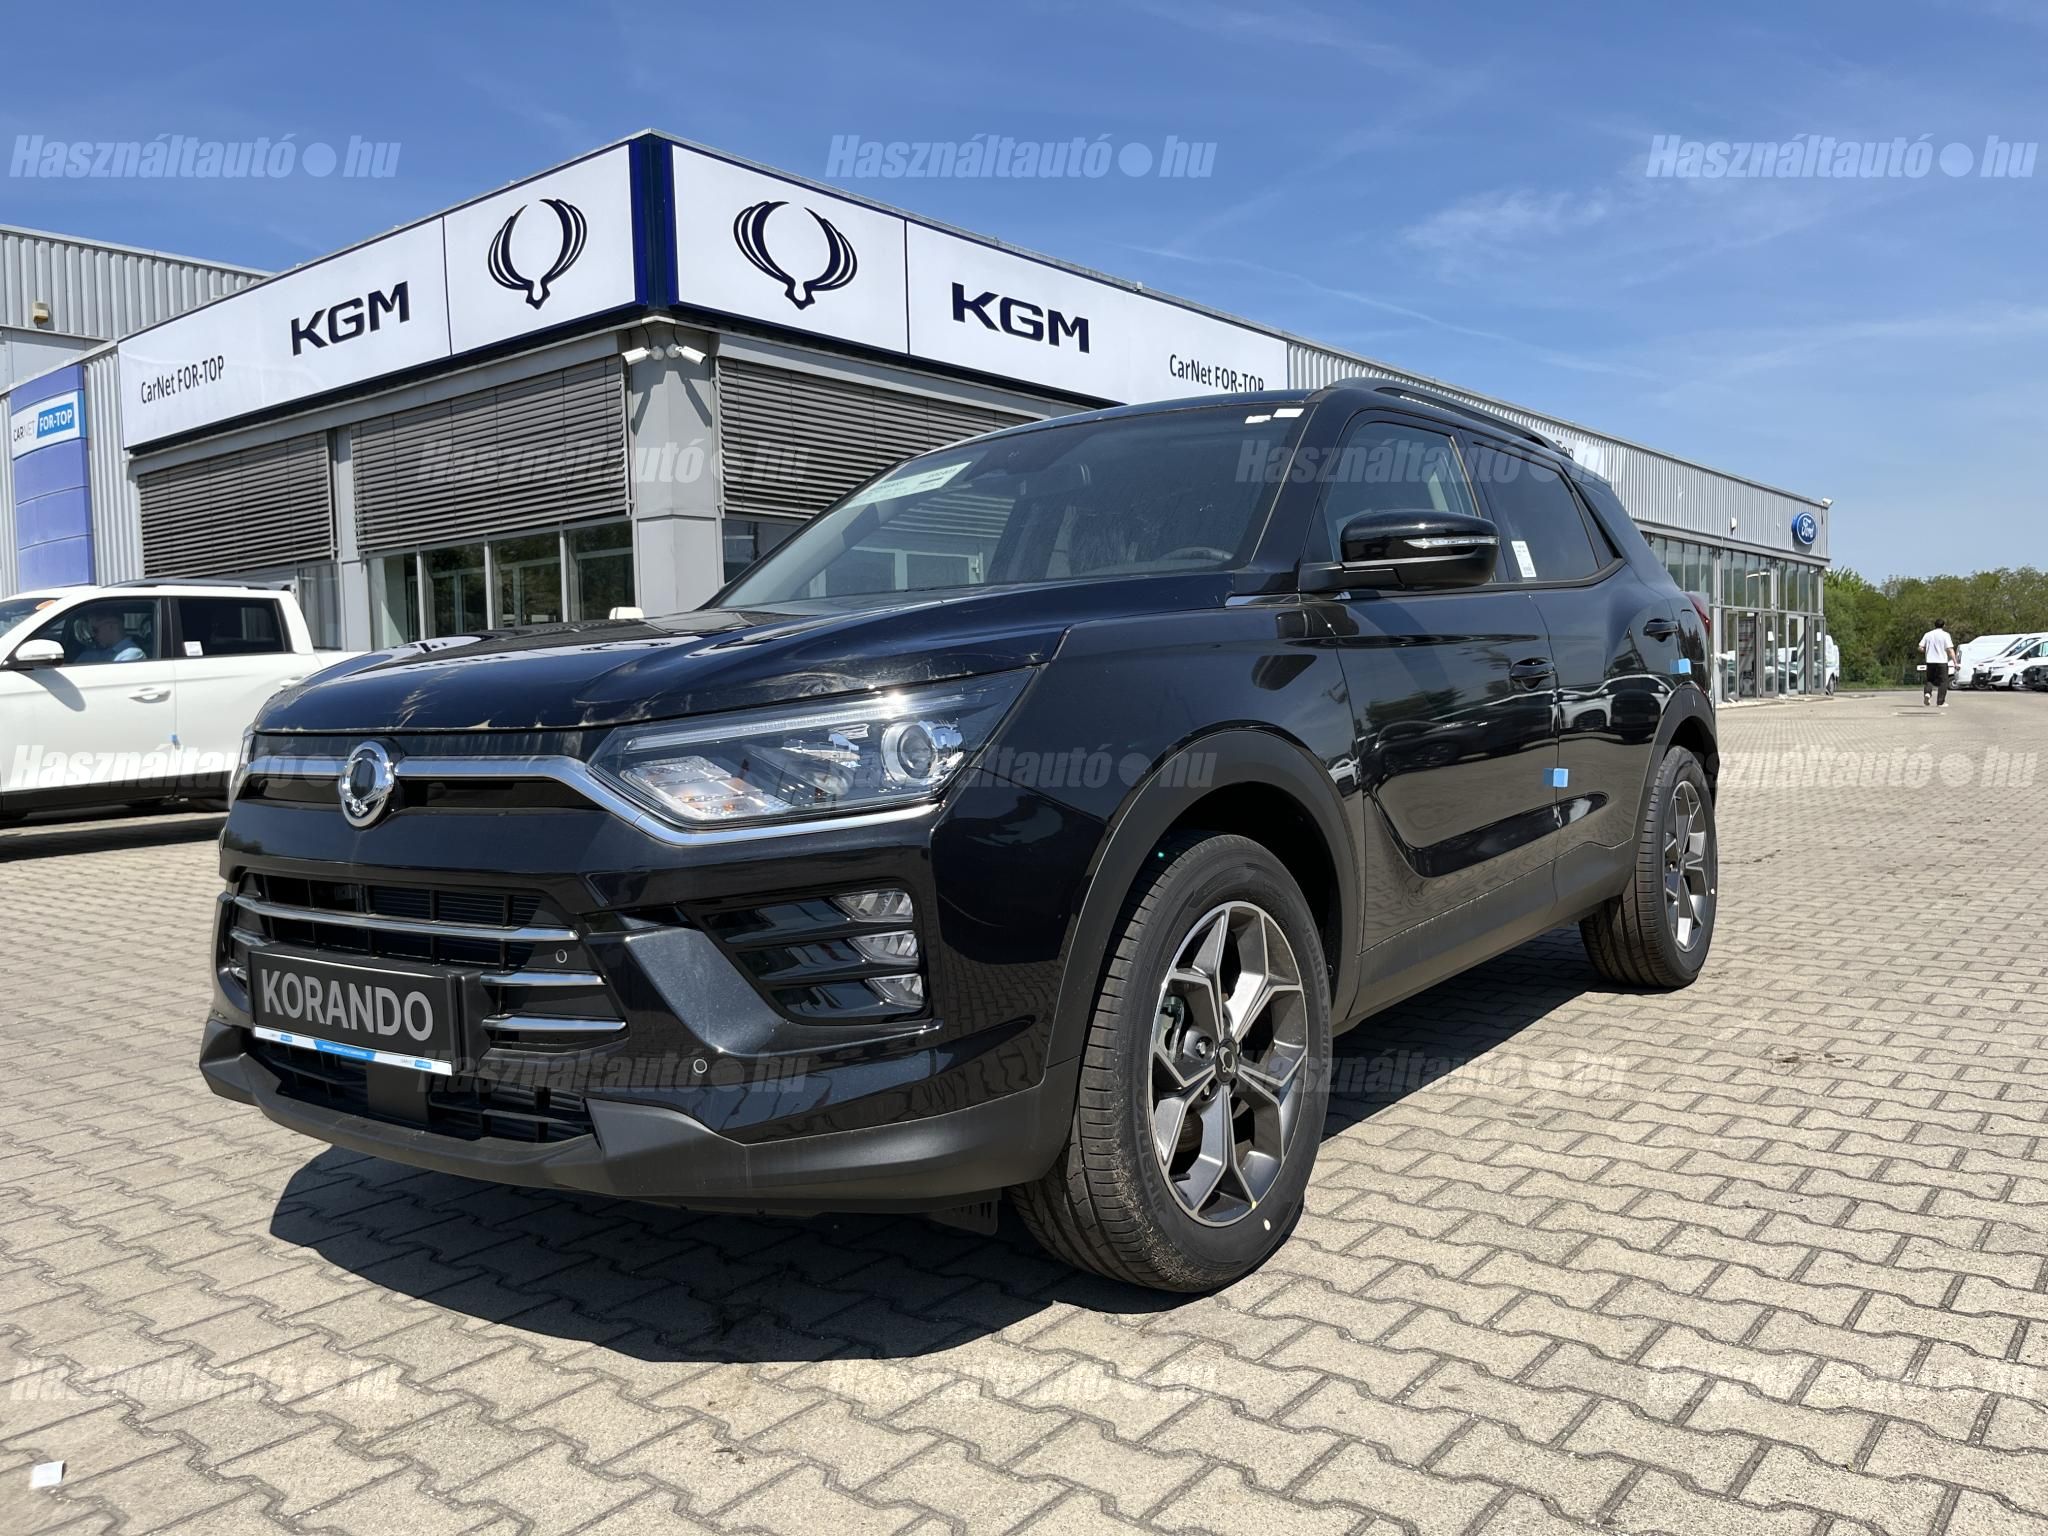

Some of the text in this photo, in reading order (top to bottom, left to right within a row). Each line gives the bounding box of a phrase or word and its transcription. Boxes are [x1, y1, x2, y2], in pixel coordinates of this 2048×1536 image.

[291, 281, 410, 356] KGM
[952, 282, 1090, 353] KGM
[141, 355, 224, 404] CarNet FOR-TOP
[1169, 354, 1212, 386] CarNet
[39, 408, 73, 432] FOR-TOP
[261, 968, 434, 1042] KORANDO
